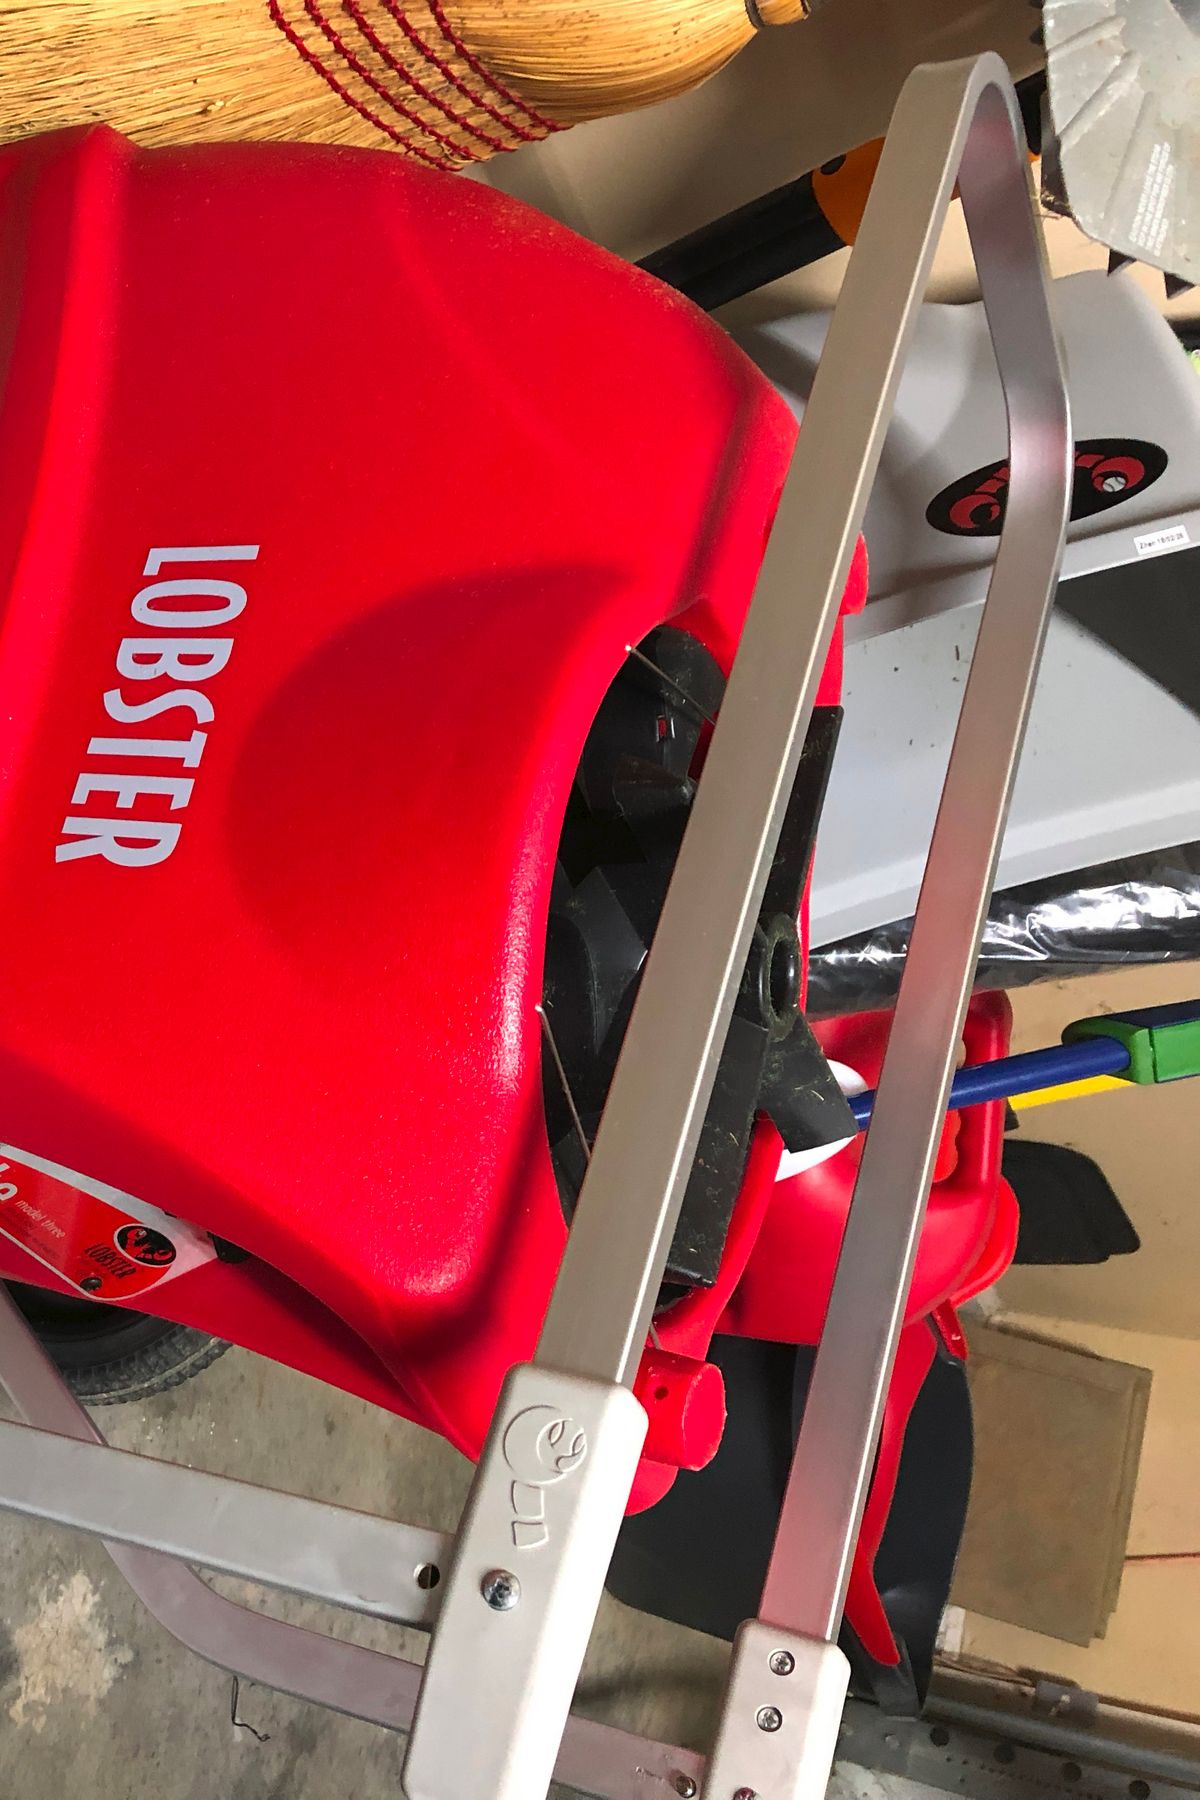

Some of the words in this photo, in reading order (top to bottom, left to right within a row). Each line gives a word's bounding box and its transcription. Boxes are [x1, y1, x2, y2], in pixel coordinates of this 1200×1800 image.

[55, 544, 260, 867] LOBSTER
[15, 1199, 45, 1224] model
[42, 1215, 67, 1239] three
[84, 1242, 137, 1279] LOBSTER
